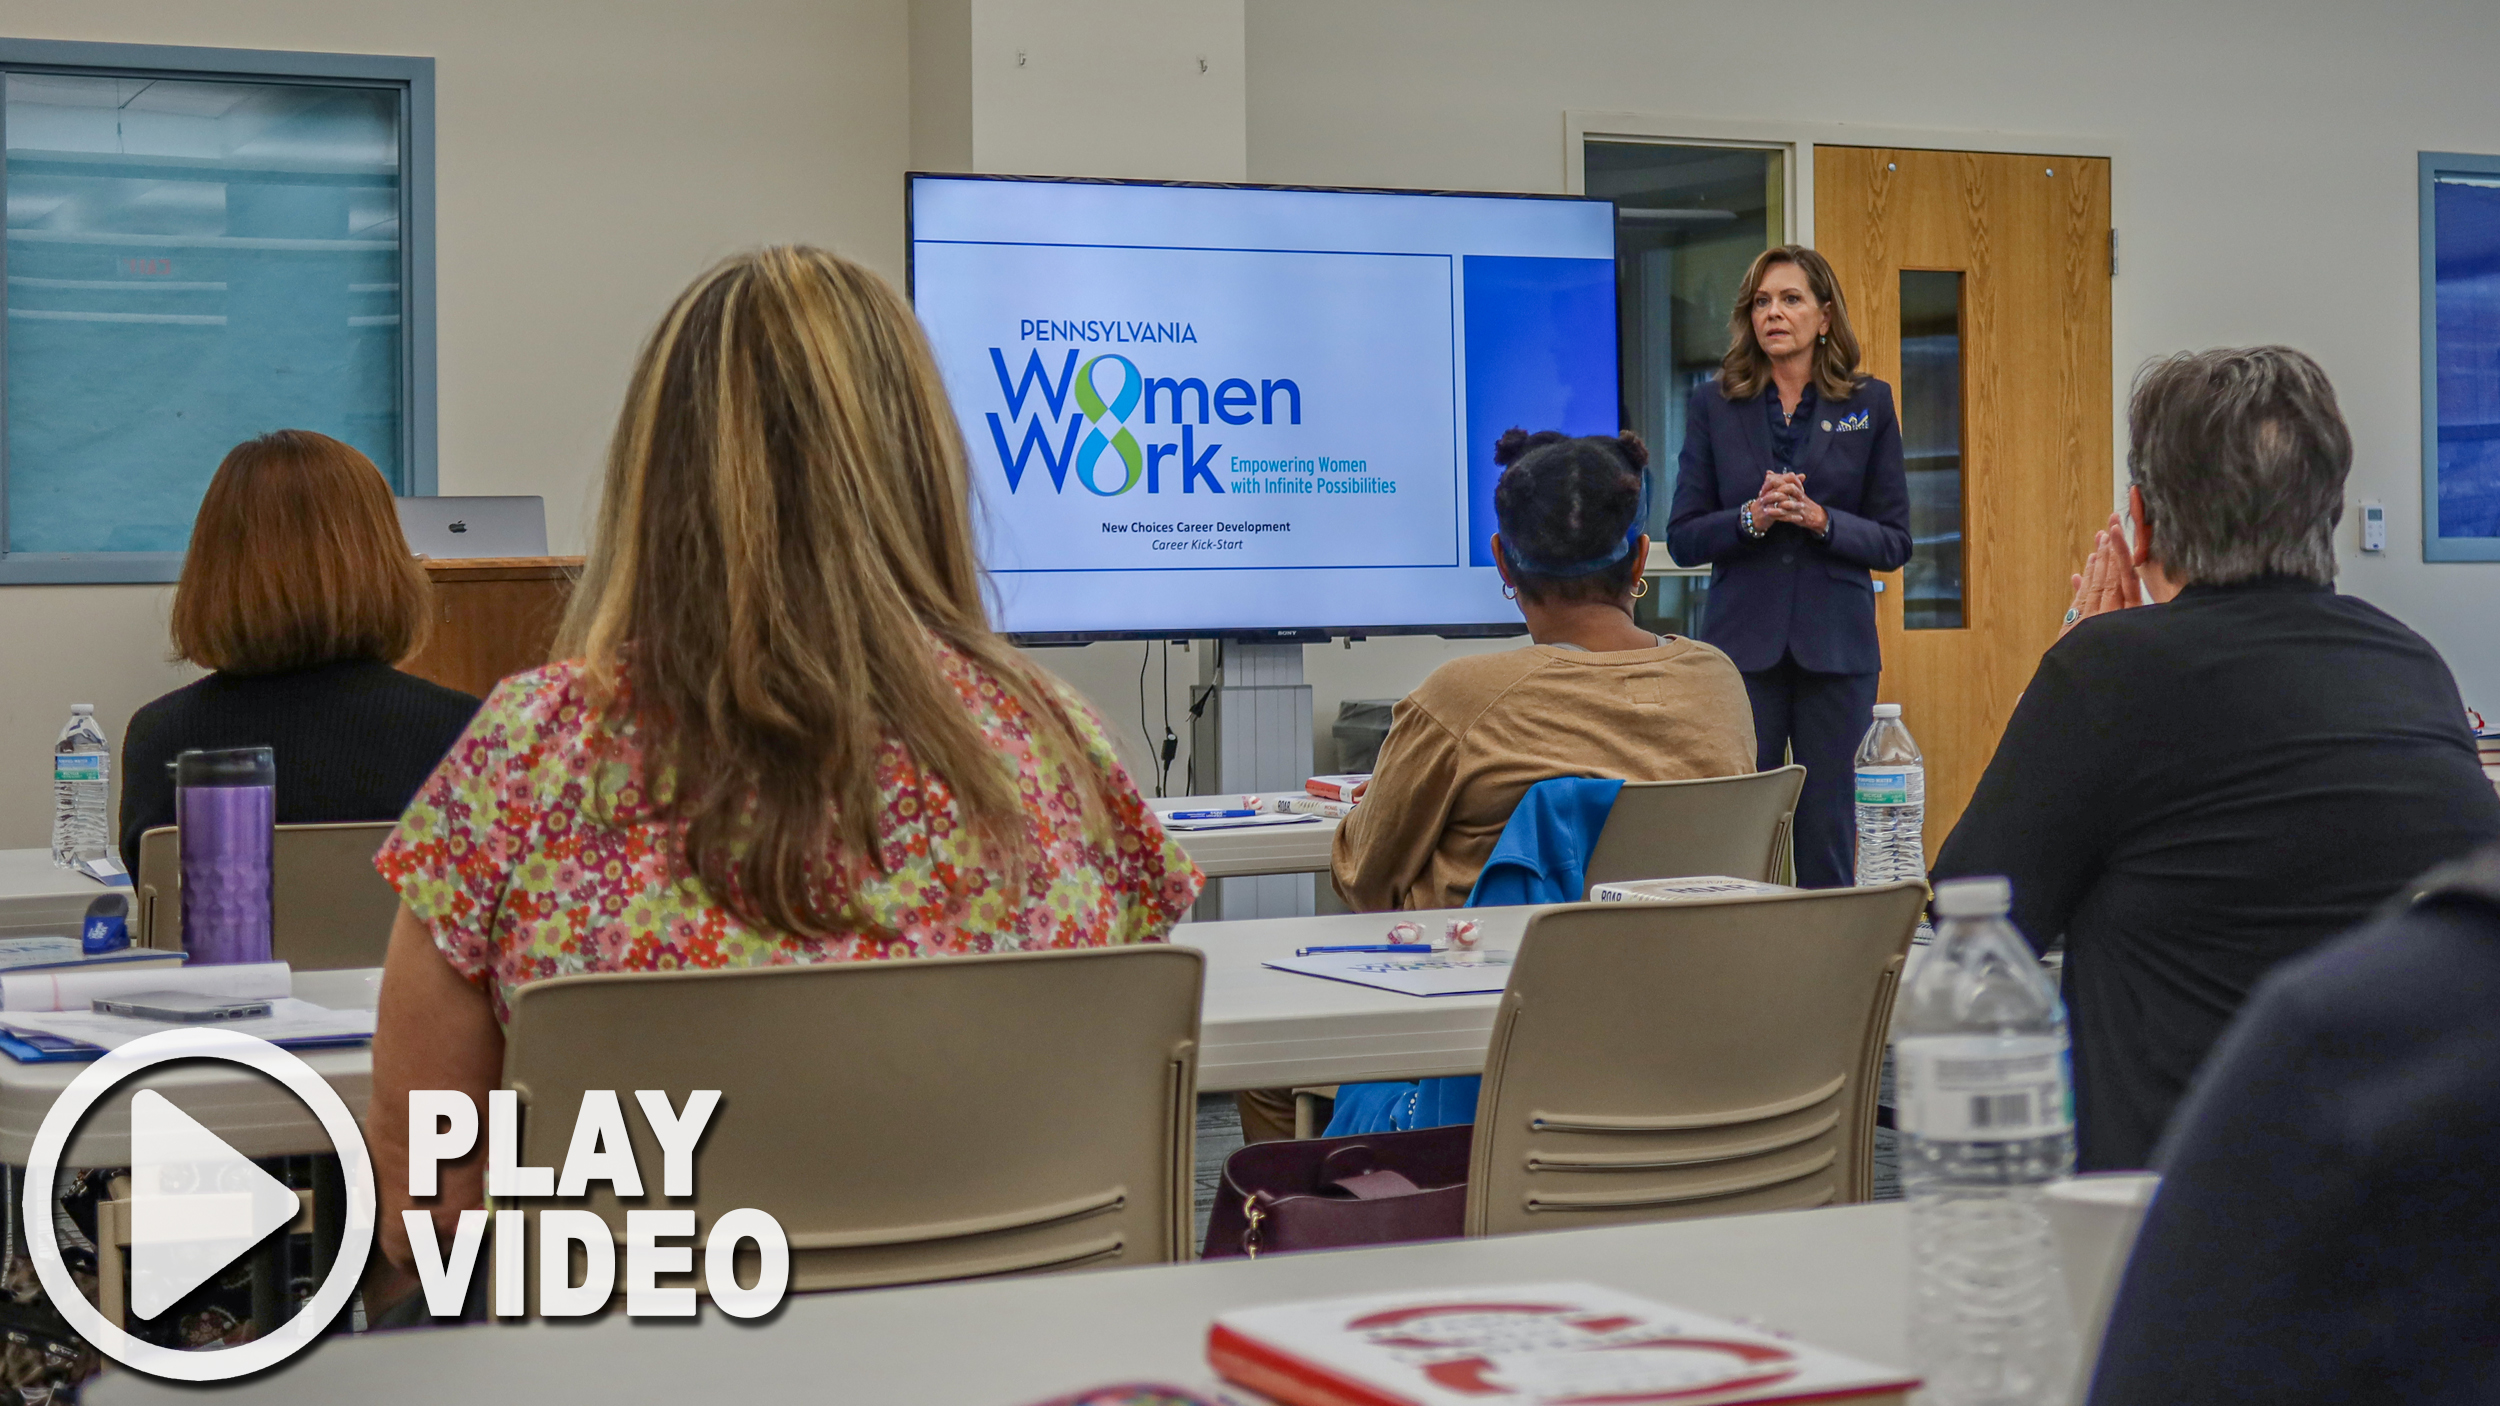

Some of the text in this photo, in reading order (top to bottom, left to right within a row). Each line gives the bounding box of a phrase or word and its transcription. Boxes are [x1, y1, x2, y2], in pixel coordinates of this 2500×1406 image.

[1020, 319, 1198, 343] PENNSYLVANIA
[988, 347, 1301, 425] Women
[985, 412, 1226, 497] Work
[1231, 456, 1367, 476] Empowering Women
[1230, 477, 1397, 494] with Infinite Possibilities
[1101, 520, 1291, 534] New Choices Career Development
[1152, 538, 1244, 551] Career Kick-Start
